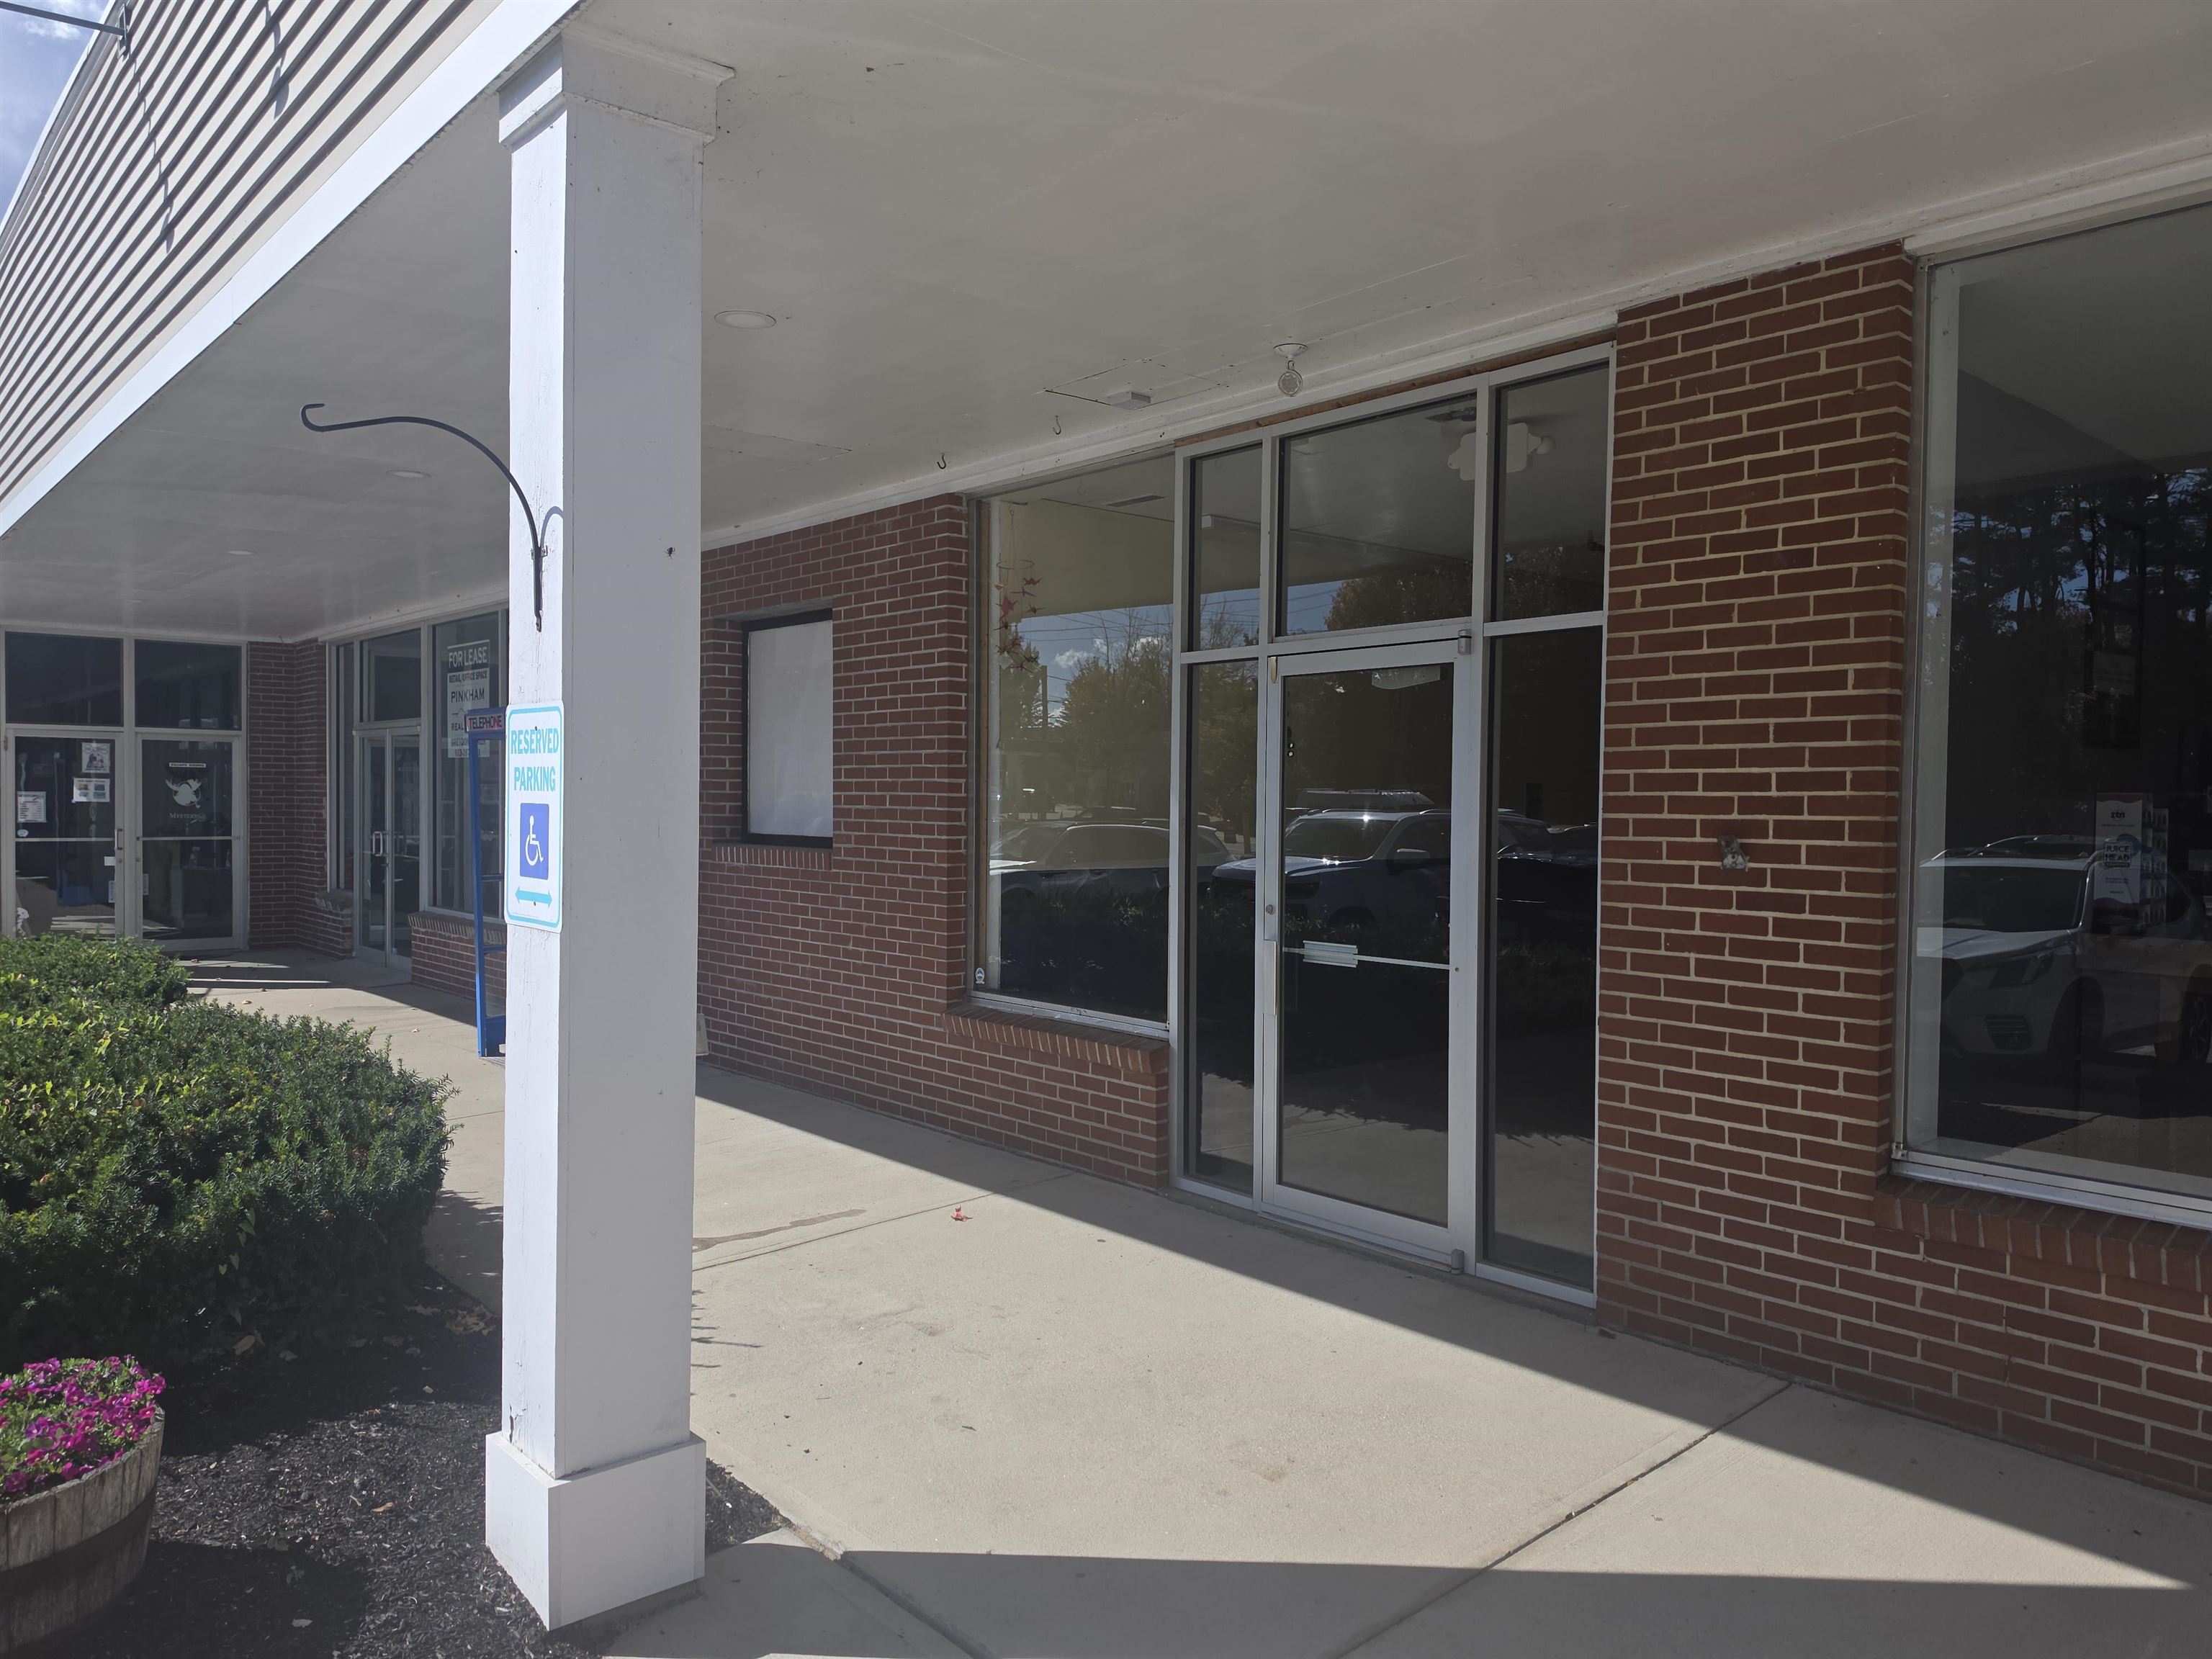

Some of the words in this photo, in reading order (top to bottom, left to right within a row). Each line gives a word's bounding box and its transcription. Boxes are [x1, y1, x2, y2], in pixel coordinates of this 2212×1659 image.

[449, 650, 462, 669] FOR
[464, 647, 487, 666] LEASE
[451, 688, 485, 703] PINKHAM
[451, 722, 464, 732] REAL
[468, 715, 503, 730] TELEPHONE
[511, 727, 559, 755] RESERVED
[513, 766, 556, 792] PARKING
